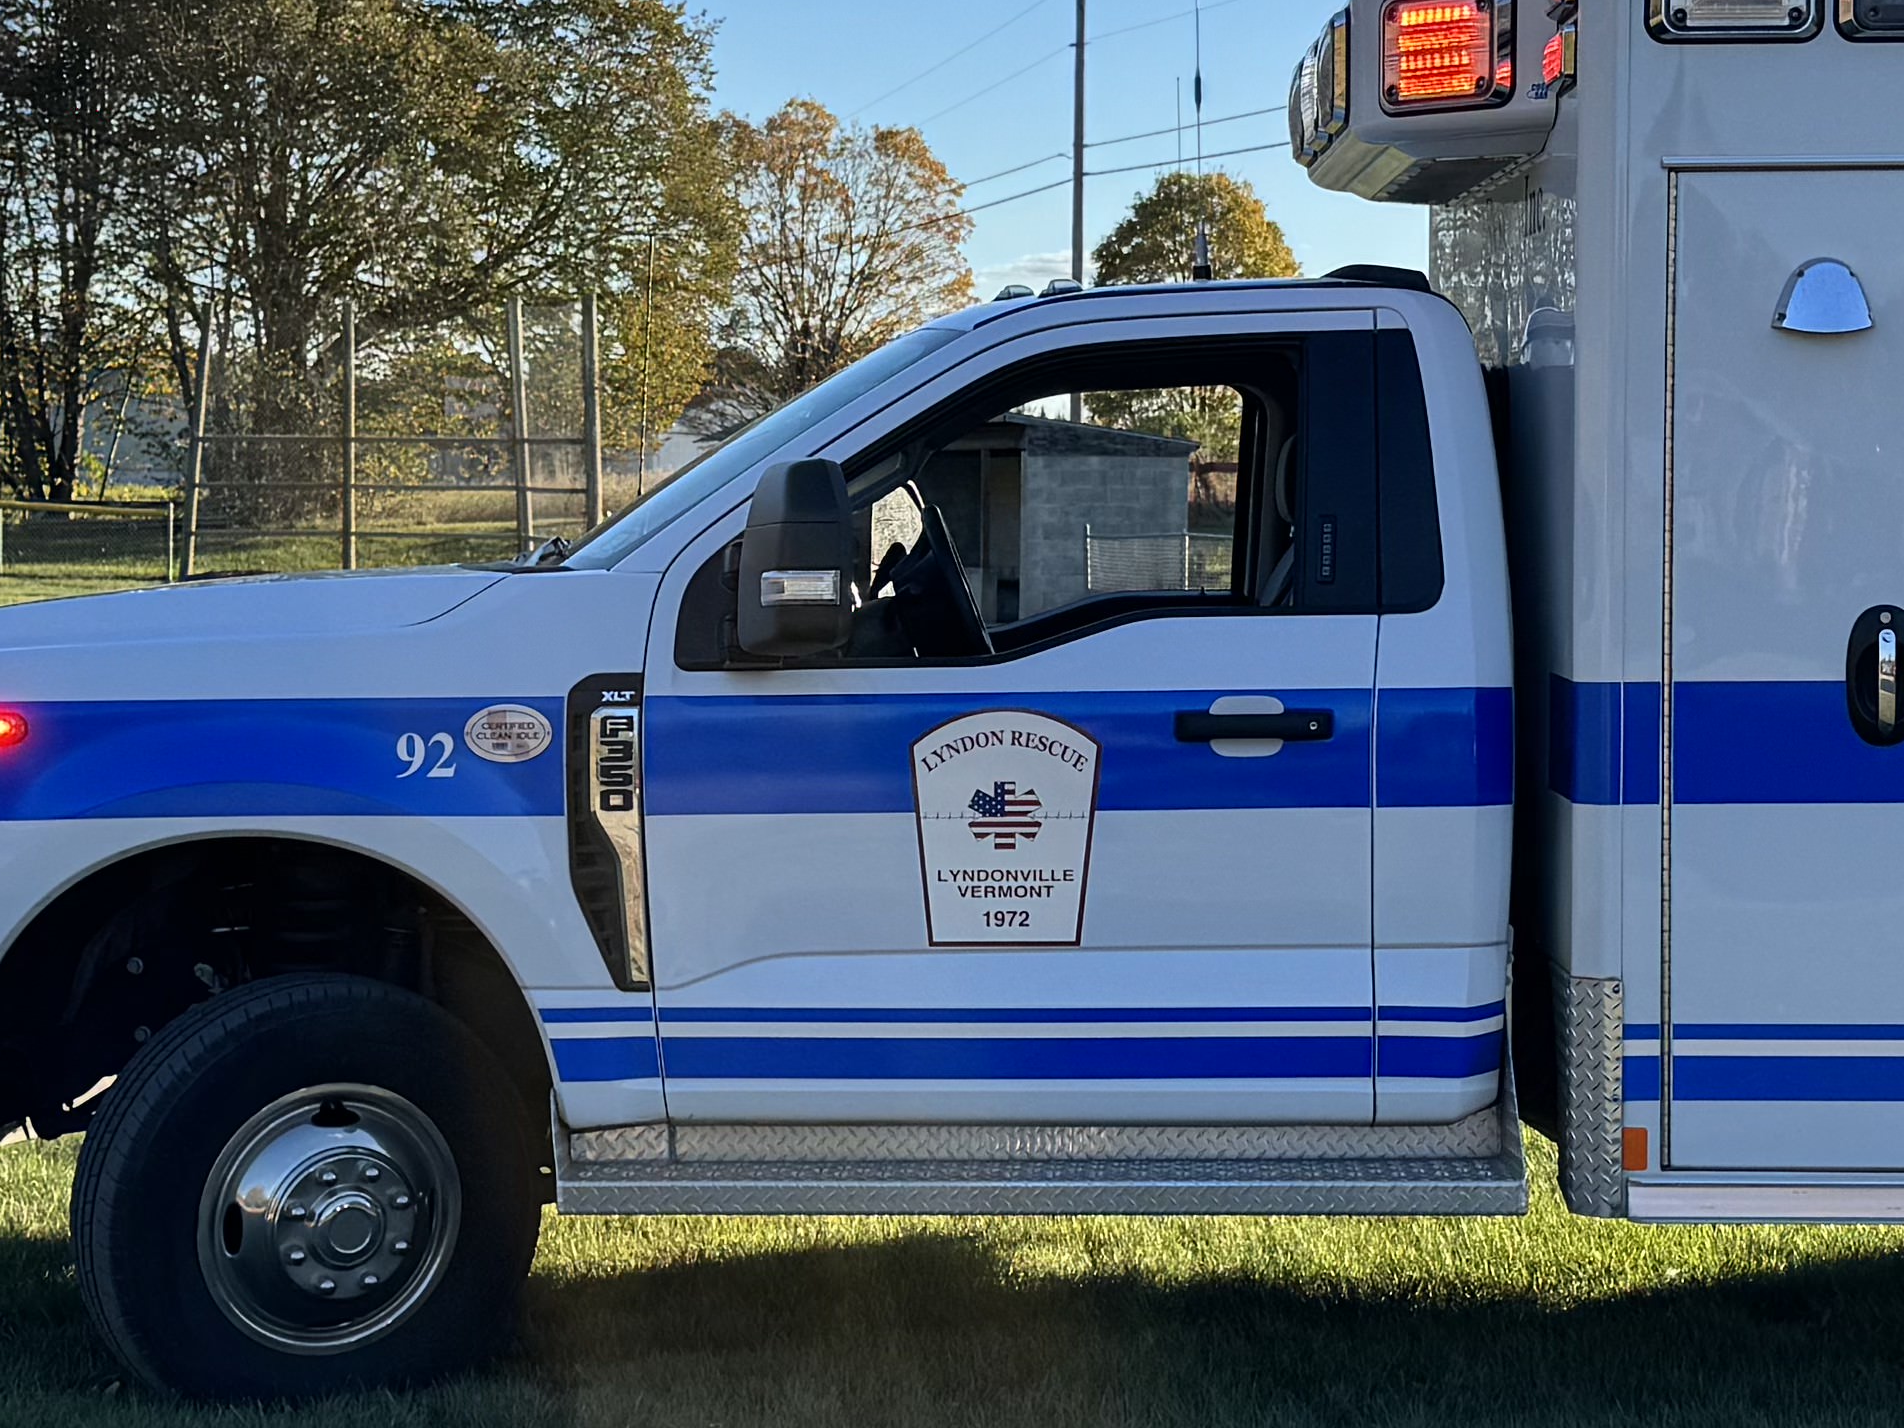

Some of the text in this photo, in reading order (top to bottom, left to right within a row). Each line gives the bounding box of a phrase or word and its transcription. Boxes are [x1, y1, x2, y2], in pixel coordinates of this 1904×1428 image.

[601, 690, 636, 703] XLT
[481, 722, 536, 731] CERTIFIED
[476, 731, 541, 740] CLEAN IDLE
[395, 731, 457, 779] 92
[921, 729, 1089, 773] LYNDON RESCUE
[599, 715, 635, 812] F350
[936, 869, 1076, 883] LYNDONVILLE
[957, 884, 1056, 899] VERMONT
[982, 910, 1031, 928] 1972
